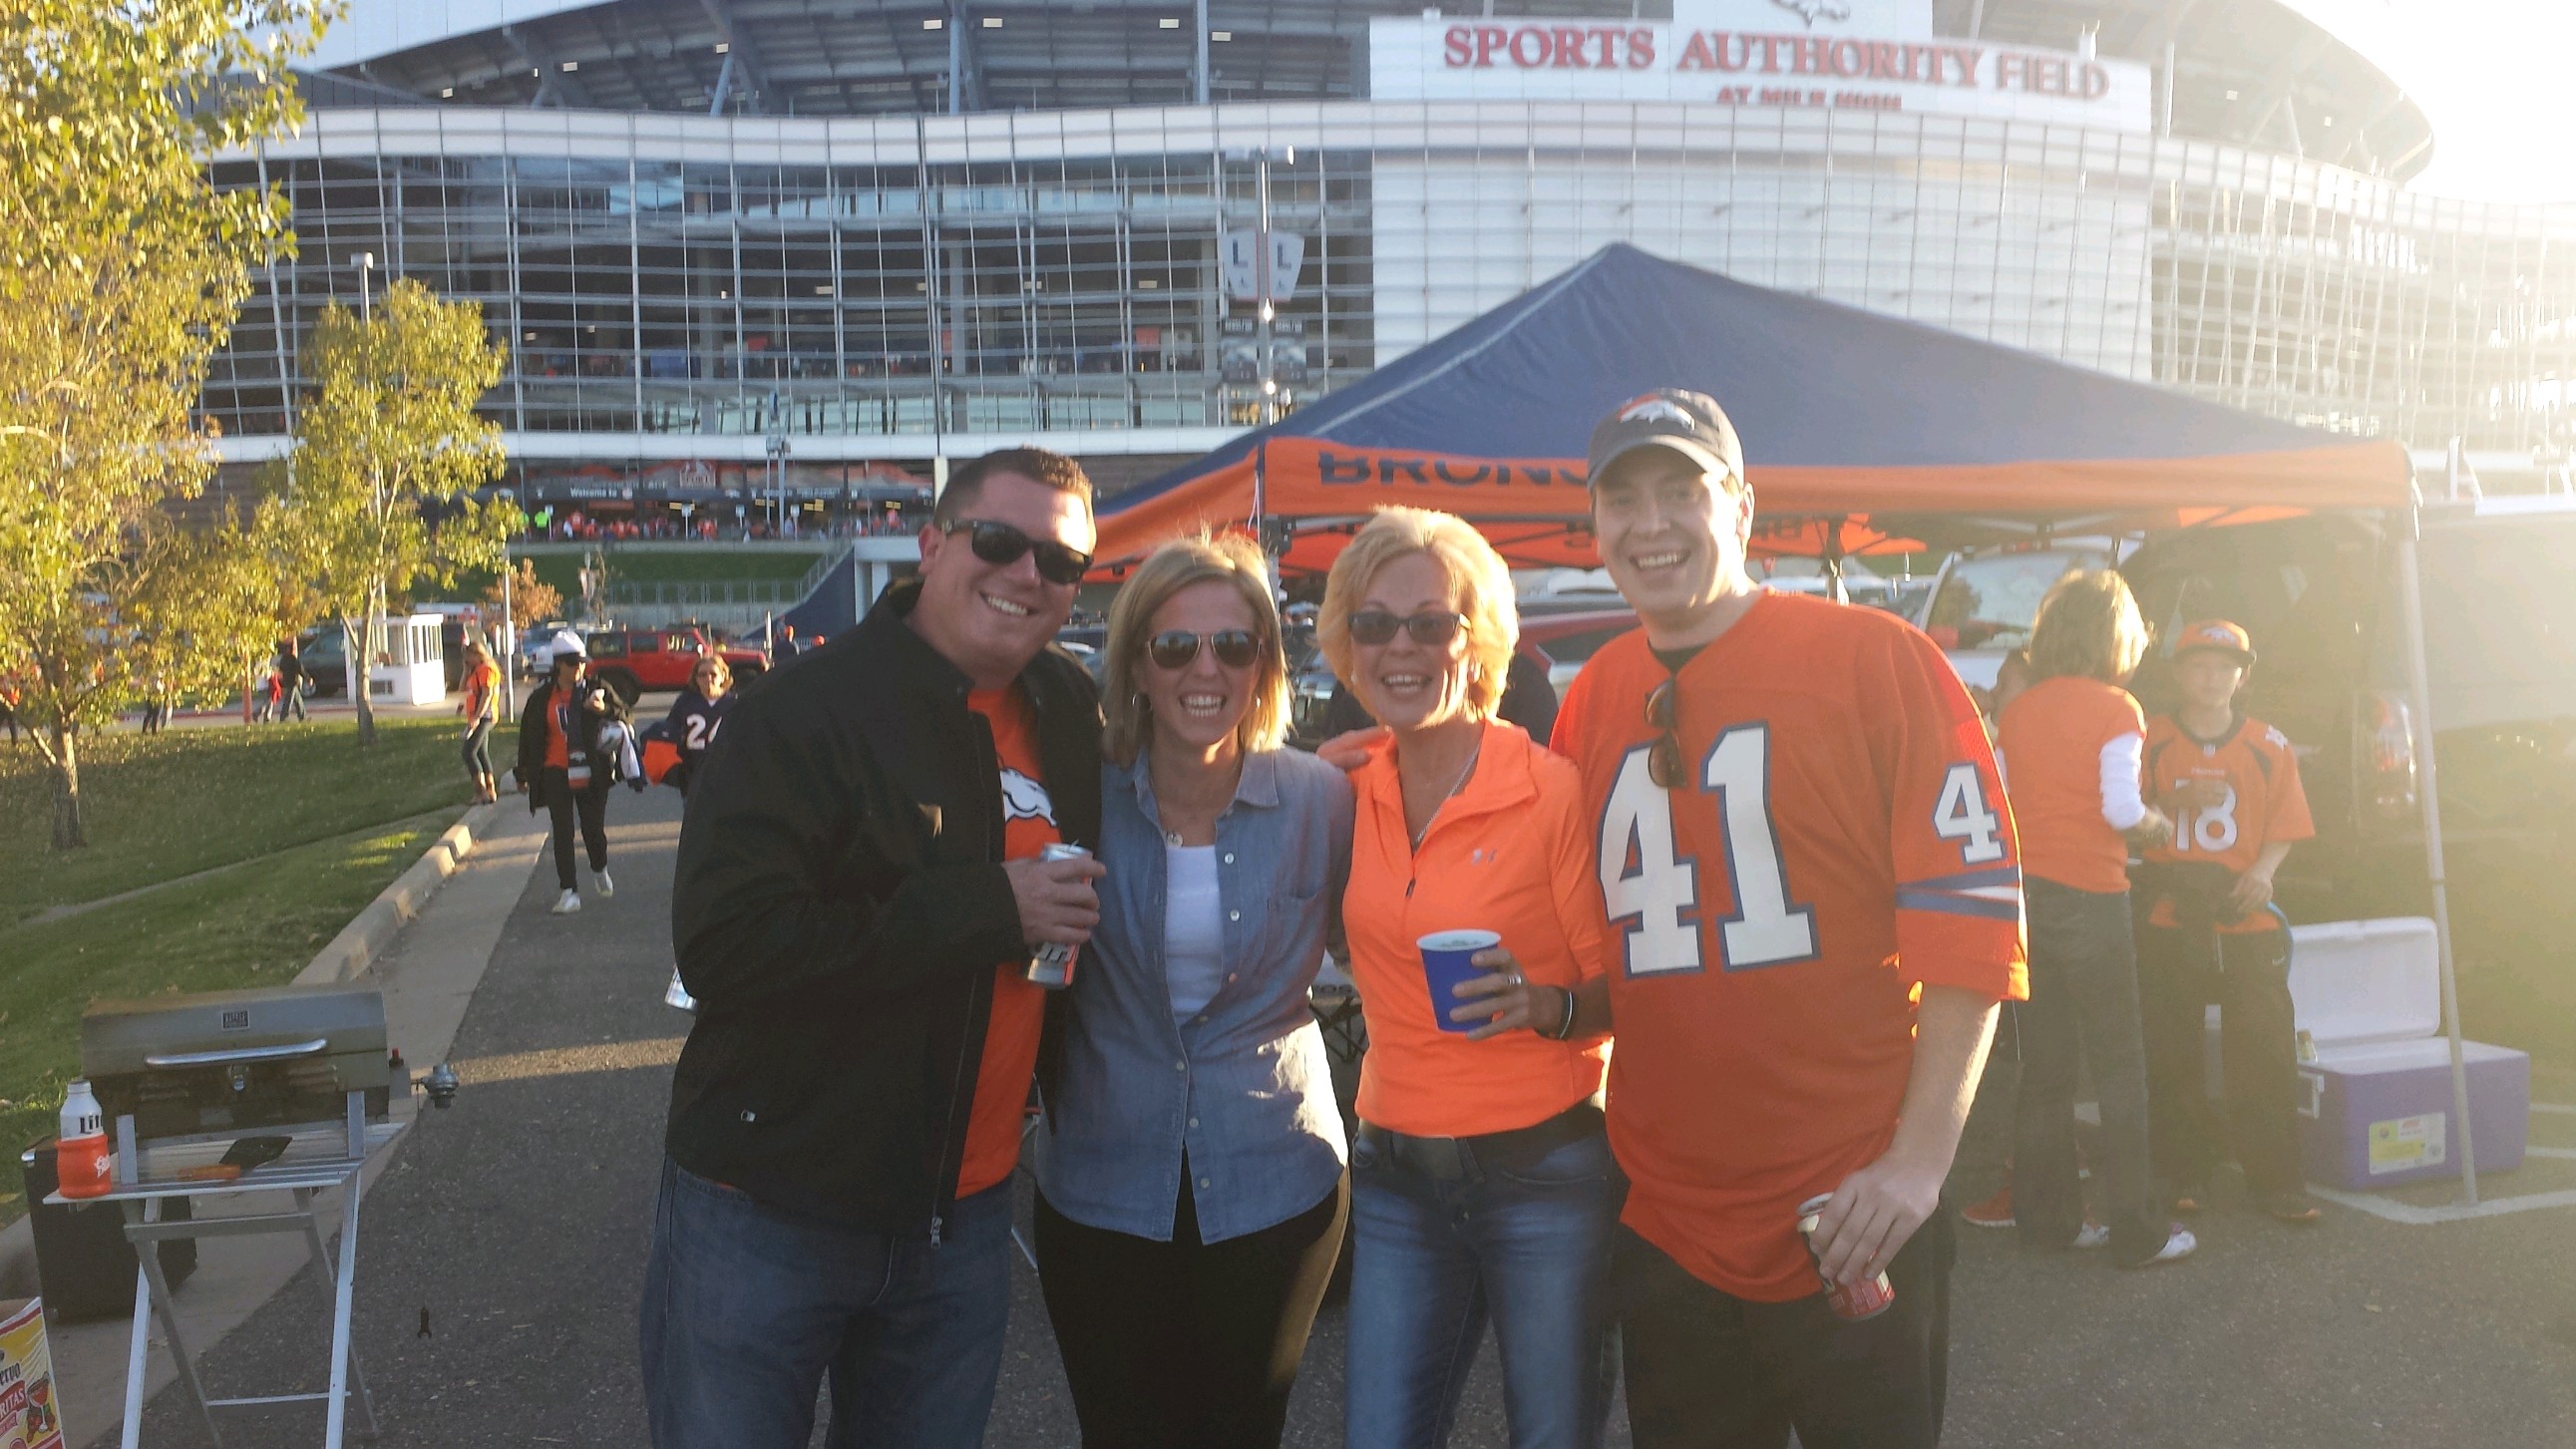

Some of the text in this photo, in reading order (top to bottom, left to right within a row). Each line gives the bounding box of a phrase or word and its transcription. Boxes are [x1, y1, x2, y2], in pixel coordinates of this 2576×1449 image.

[1444, 26, 2109, 101] SPORTS AUTHORITY FIELD
[1717, 85, 1752, 105] AT
[1233, 238, 1248, 267] L
[1278, 241, 1292, 270] L
[1600, 721, 1819, 978] 41
[1932, 762, 2008, 865] 4
[2174, 779, 2238, 853] 18
